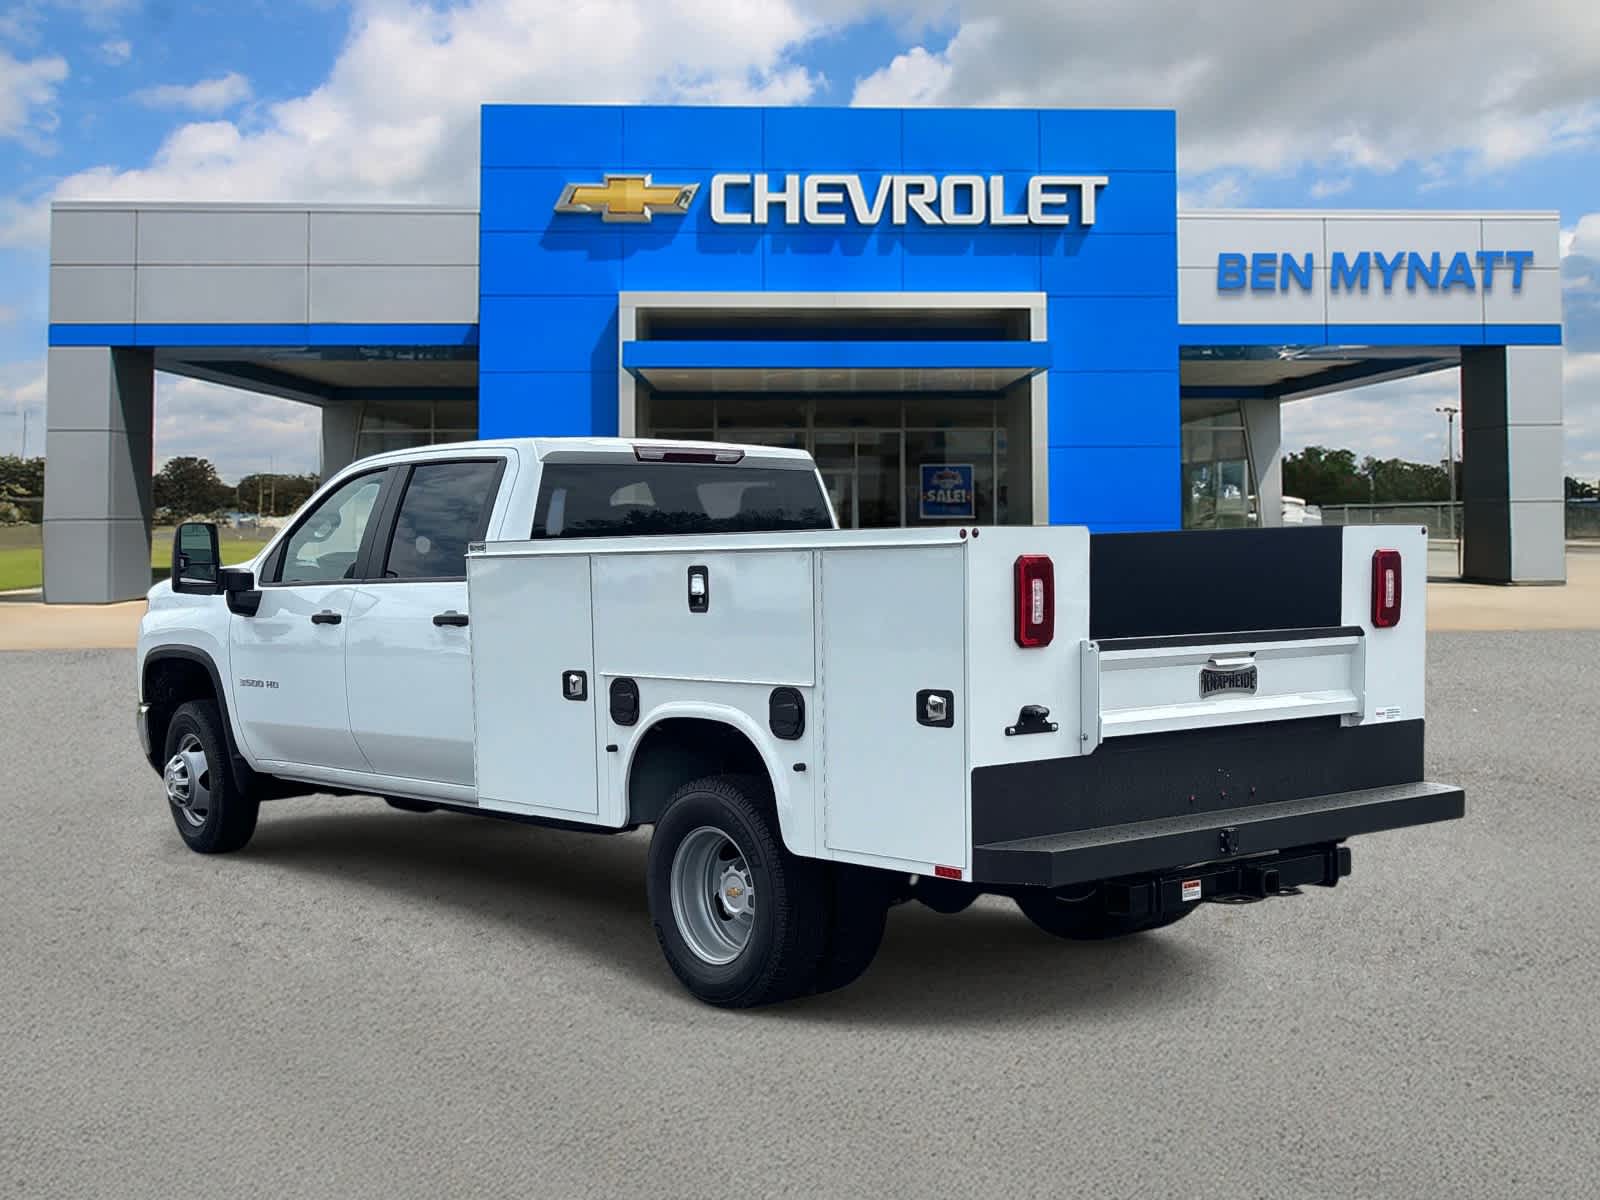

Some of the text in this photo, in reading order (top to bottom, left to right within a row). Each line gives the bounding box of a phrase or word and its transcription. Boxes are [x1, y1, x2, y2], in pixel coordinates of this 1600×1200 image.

[711, 174, 1109, 224] CHEVROLET
[1217, 250, 1534, 290] BEN MYNATT
[266, 680, 280, 689] HD
[1201, 670, 1256, 693] KNAPHEIDE
